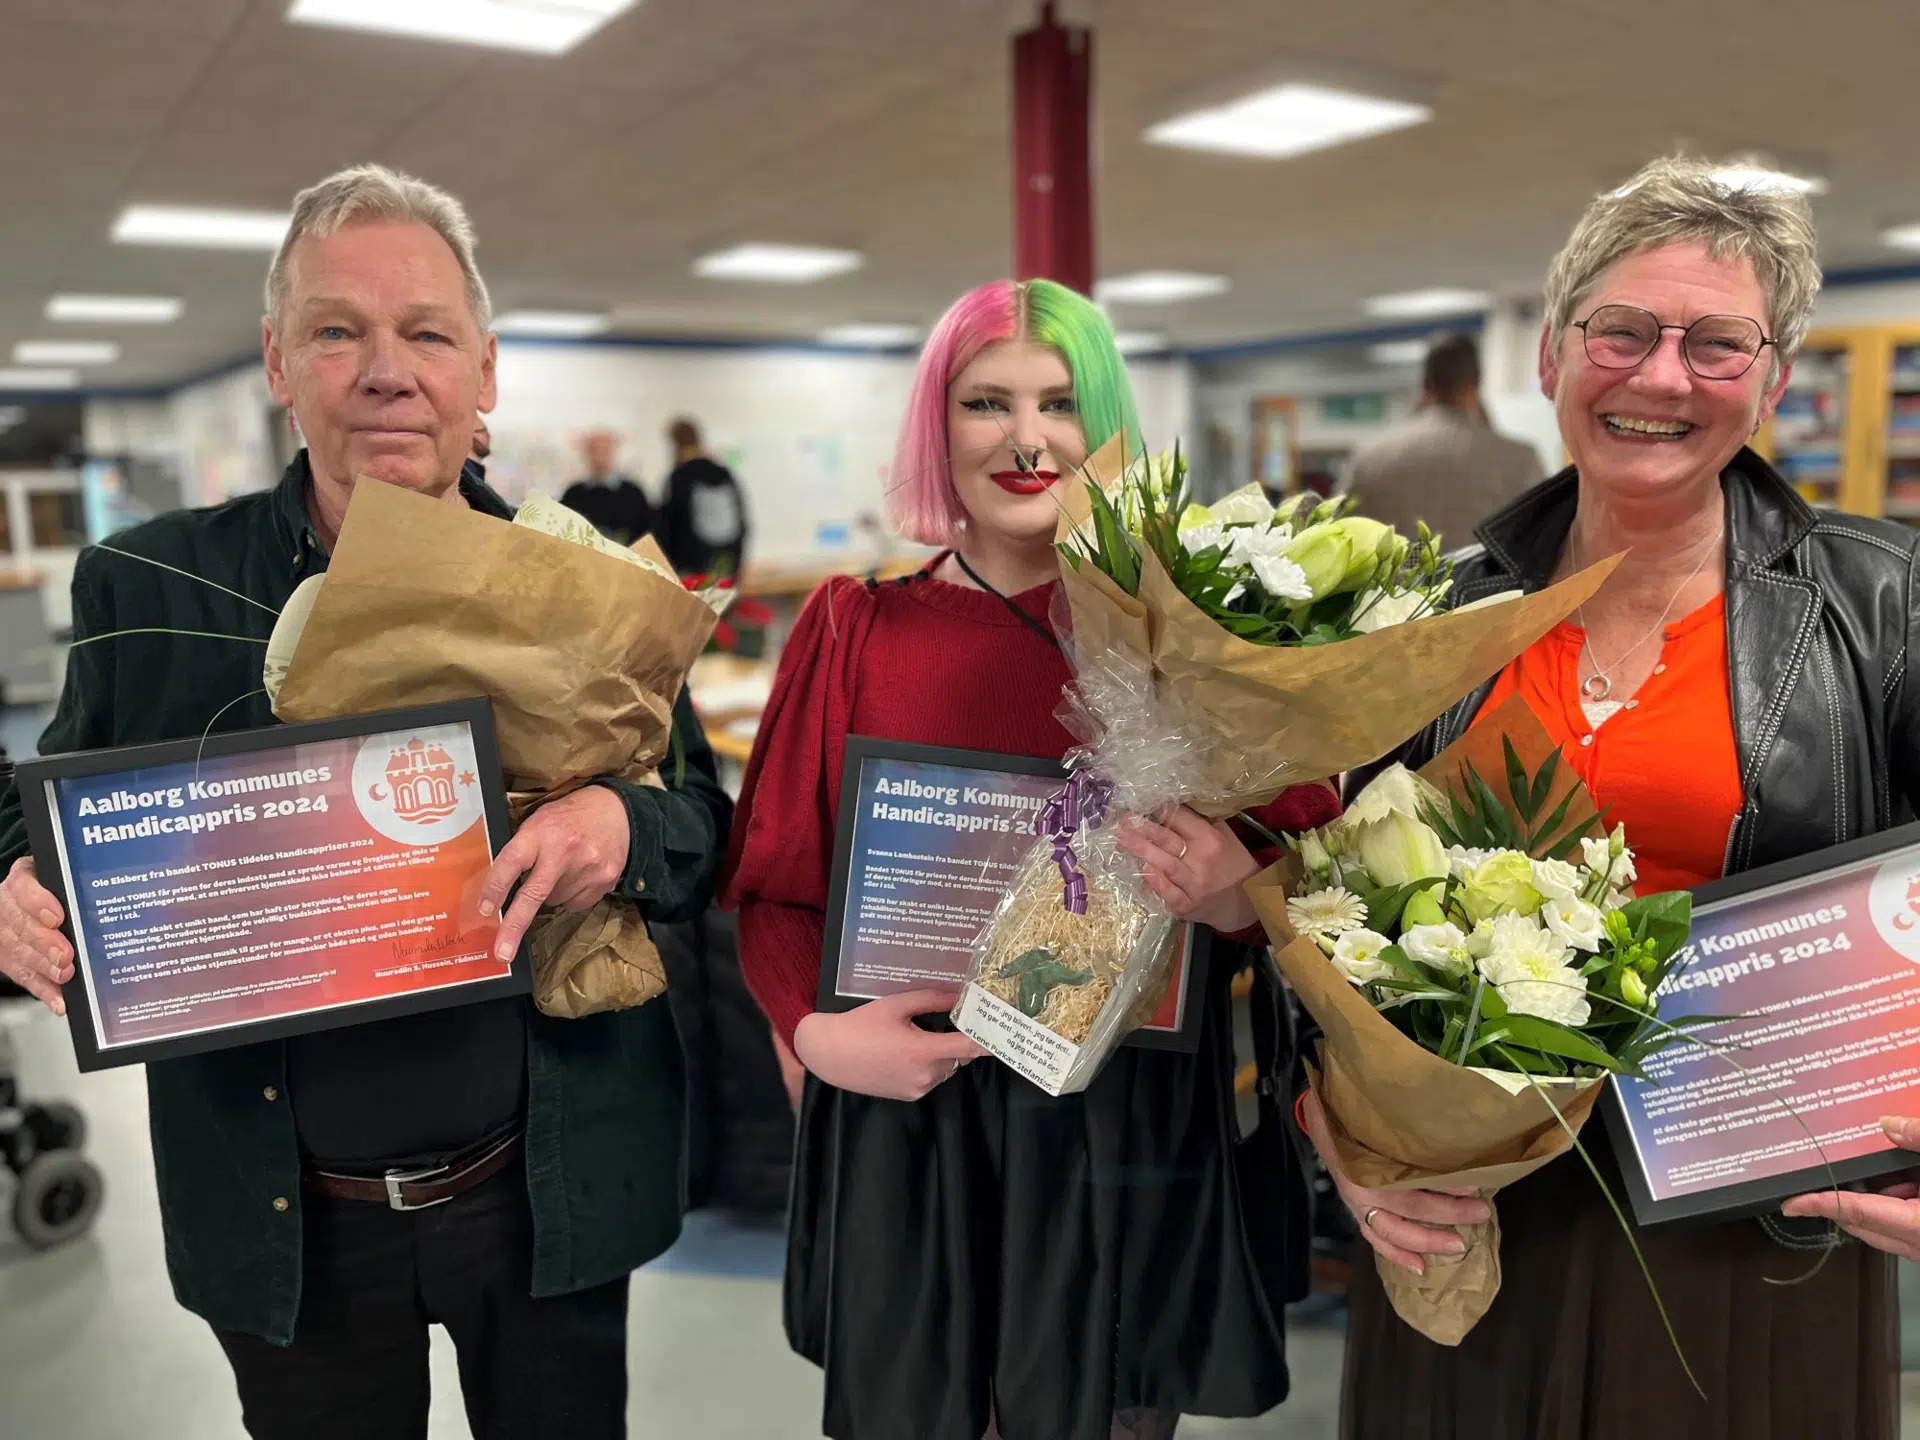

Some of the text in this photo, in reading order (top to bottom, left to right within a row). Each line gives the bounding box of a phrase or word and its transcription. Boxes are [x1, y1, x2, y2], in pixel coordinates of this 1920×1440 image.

[78, 766, 331, 816] Aalborg Kommunes
[875, 778, 1048, 811] Aalborg Kommu
[82, 793, 329, 846] Handicappris 2024
[872, 802, 1038, 835] Handicappris 20
[91, 879, 109, 887] Ole
[110, 874, 148, 884] Elsberg
[165, 864, 200, 876] bandet
[201, 858, 236, 870] TONUS
[238, 854, 274, 864] tildeles
[275, 842, 348, 858] Handicapprisen
[349, 837, 374, 847] 2024
[95, 895, 125, 905] Bandet
[126, 891, 156, 901] TONUS
[172, 885, 198, 895] prisen
[213, 879, 236, 887] deres
[237, 874, 267, 883] indsats
[268, 870, 285, 878] med
[297, 865, 324, 874] sprede
[326, 861, 350, 869] varme
[936, 855, 946, 863] fra
[947, 857, 972, 866] bandet
[999, 862, 1018, 870] tilde
[108, 905, 131, 913] deres
[132, 898, 174, 909] erfaringer
[176, 894, 197, 902] med,
[220, 883, 259, 895] erhvervet
[261, 876, 310, 889] hjerneskade
[408, 857, 434, 865] tilbage
[102, 930, 132, 940] TONUS
[149, 923, 172, 933] skabt
[185, 918, 206, 927] unikt
[264, 905, 282, 914] haft
[301, 897, 341, 908] betydning
[355, 891, 377, 899] deres
[379, 888, 397, 896] egen
[105, 936, 163, 949] rehabilitering.
[164, 928, 206, 939] Derudover
[208, 922, 240, 933] spreder
[288, 906, 330, 919] budskabet
[347, 900, 379, 909] hvordan
[124, 911, 140, 919] stå.
[1699, 903, 1848, 956] Kommunes
[106, 950, 125, 960] godt
[127, 946, 144, 955] med
[158, 937, 198, 949] erhvervet
[199, 930, 252, 943] hjerneskade.
[112, 974, 152, 985] betragtes
[182, 964, 206, 972] skabe
[208, 954, 269, 968] stjernestunder
[284, 944, 327, 955] mennesker
[349, 936, 365, 944] med
[398, 926, 434, 935] handicap.
[120, 965, 135, 973] det
[155, 959, 178, 969] gøres
[180, 953, 212, 965] gennem
[213, 948, 237, 957] musik
[249, 944, 268, 953] gavn
[283, 937, 312, 945] mange,
[333, 928, 359, 937] ekstra
[416, 914, 434, 924] grad
[454, 952, 487, 963] rådmand
[1654, 950, 1775, 998] dicappris
[1779, 932, 1852, 965] 2024
[980, 996, 990, 1007] Jeg
[1759, 1000, 1791, 1016] TONUS
[972, 1031, 989, 1047] Lene
[976, 1006, 986, 1018] Jeg
[1025, 1038, 1033, 1046] er
[1033, 1043, 1043, 1051] på
[1006, 1038, 1014, 1047] og
[1014, 1043, 1024, 1054] jeg
[1025, 1050, 1037, 1061] tror
